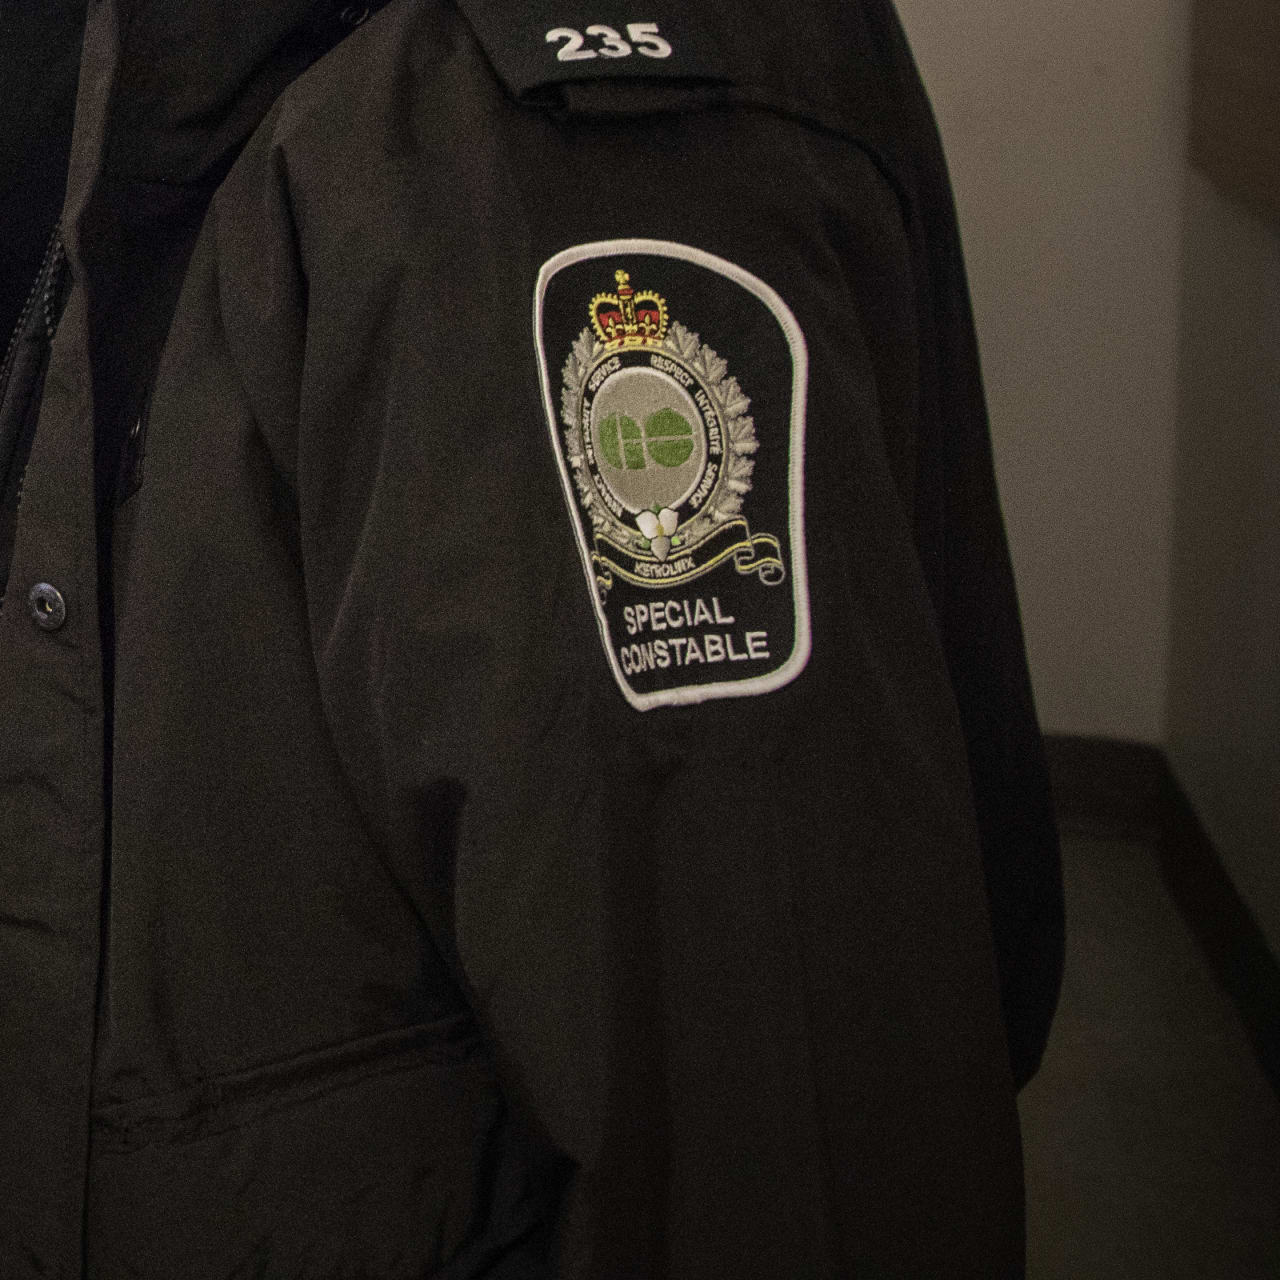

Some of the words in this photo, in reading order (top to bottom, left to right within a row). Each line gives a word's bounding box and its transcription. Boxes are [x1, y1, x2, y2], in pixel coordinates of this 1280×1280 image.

[545, 22, 672, 61] 235
[623, 597, 735, 635] SPECIAL
[620, 631, 770, 675] CONSTABLE
